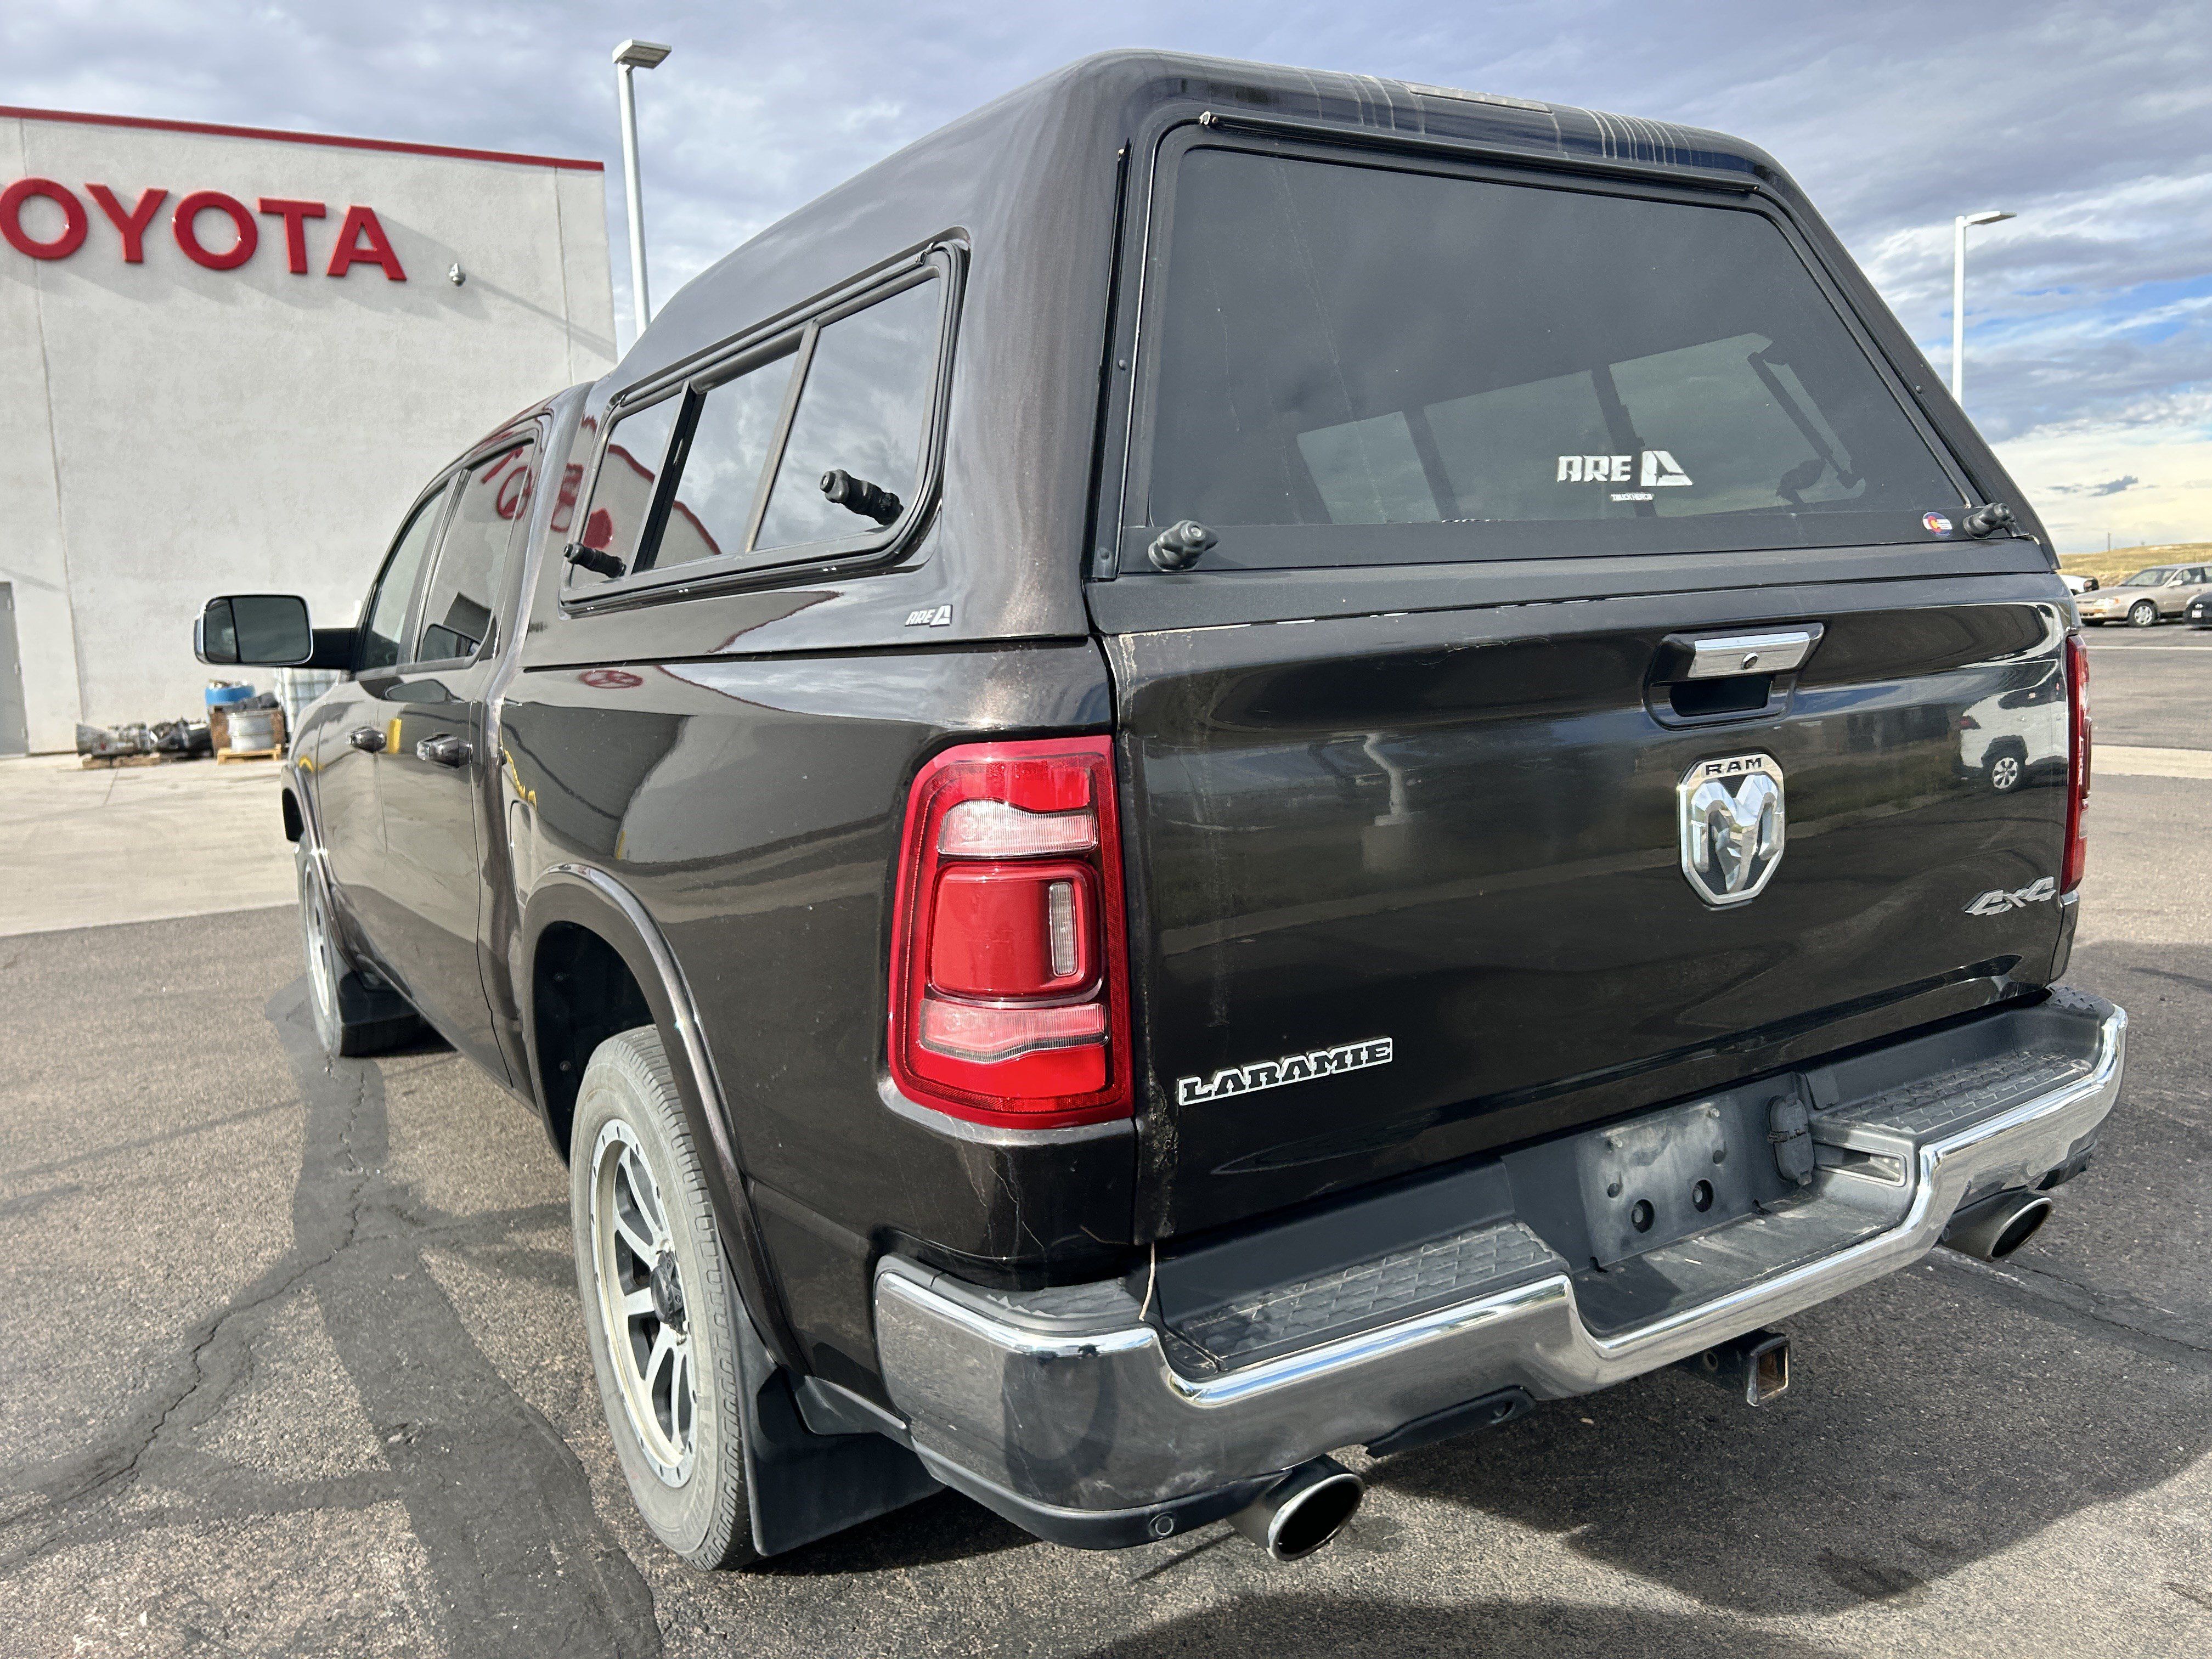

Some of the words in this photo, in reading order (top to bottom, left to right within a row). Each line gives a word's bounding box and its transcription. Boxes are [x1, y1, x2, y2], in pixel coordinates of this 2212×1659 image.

[1557, 455, 1632, 482] ARE
[905, 608, 936, 626] ARE
[1706, 758, 1762, 775] RAM
[1178, 1037, 1393, 1107] LARAMIE
